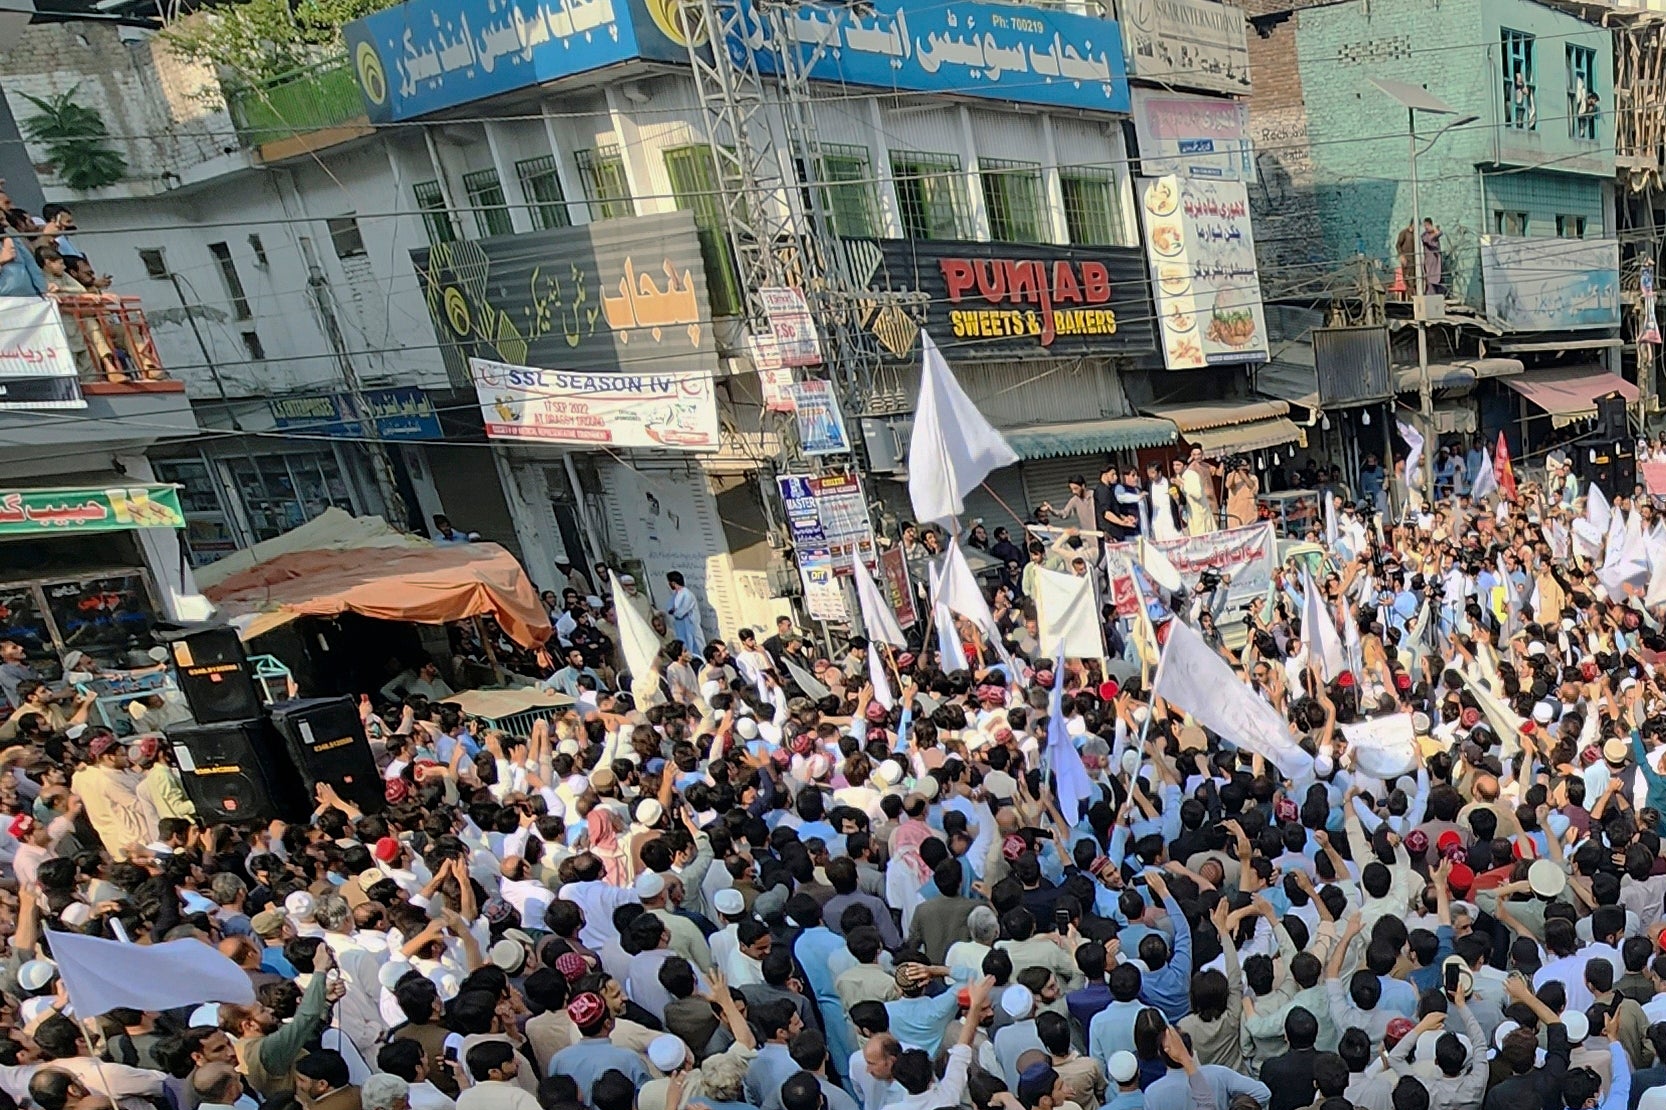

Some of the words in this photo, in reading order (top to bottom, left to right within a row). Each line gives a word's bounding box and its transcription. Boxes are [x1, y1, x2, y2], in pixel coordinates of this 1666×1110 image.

[992, 13, 1009, 30] Ph:
[1009, 16, 1045, 35] 700219
[1029, 31, 1112, 99] پنجاب
[601, 255, 700, 348] پنجاب
[940, 257, 1112, 347] PUNJAB
[951, 309, 1025, 338] SWEETS
[1024, 310, 1041, 335] &
[1053, 309, 1118, 336] BAKERS
[508, 369, 550, 388] SSL
[555, 373, 642, 392] SEASON
[650, 376, 672, 393] IV
[26, 500, 108, 527] حبیب
